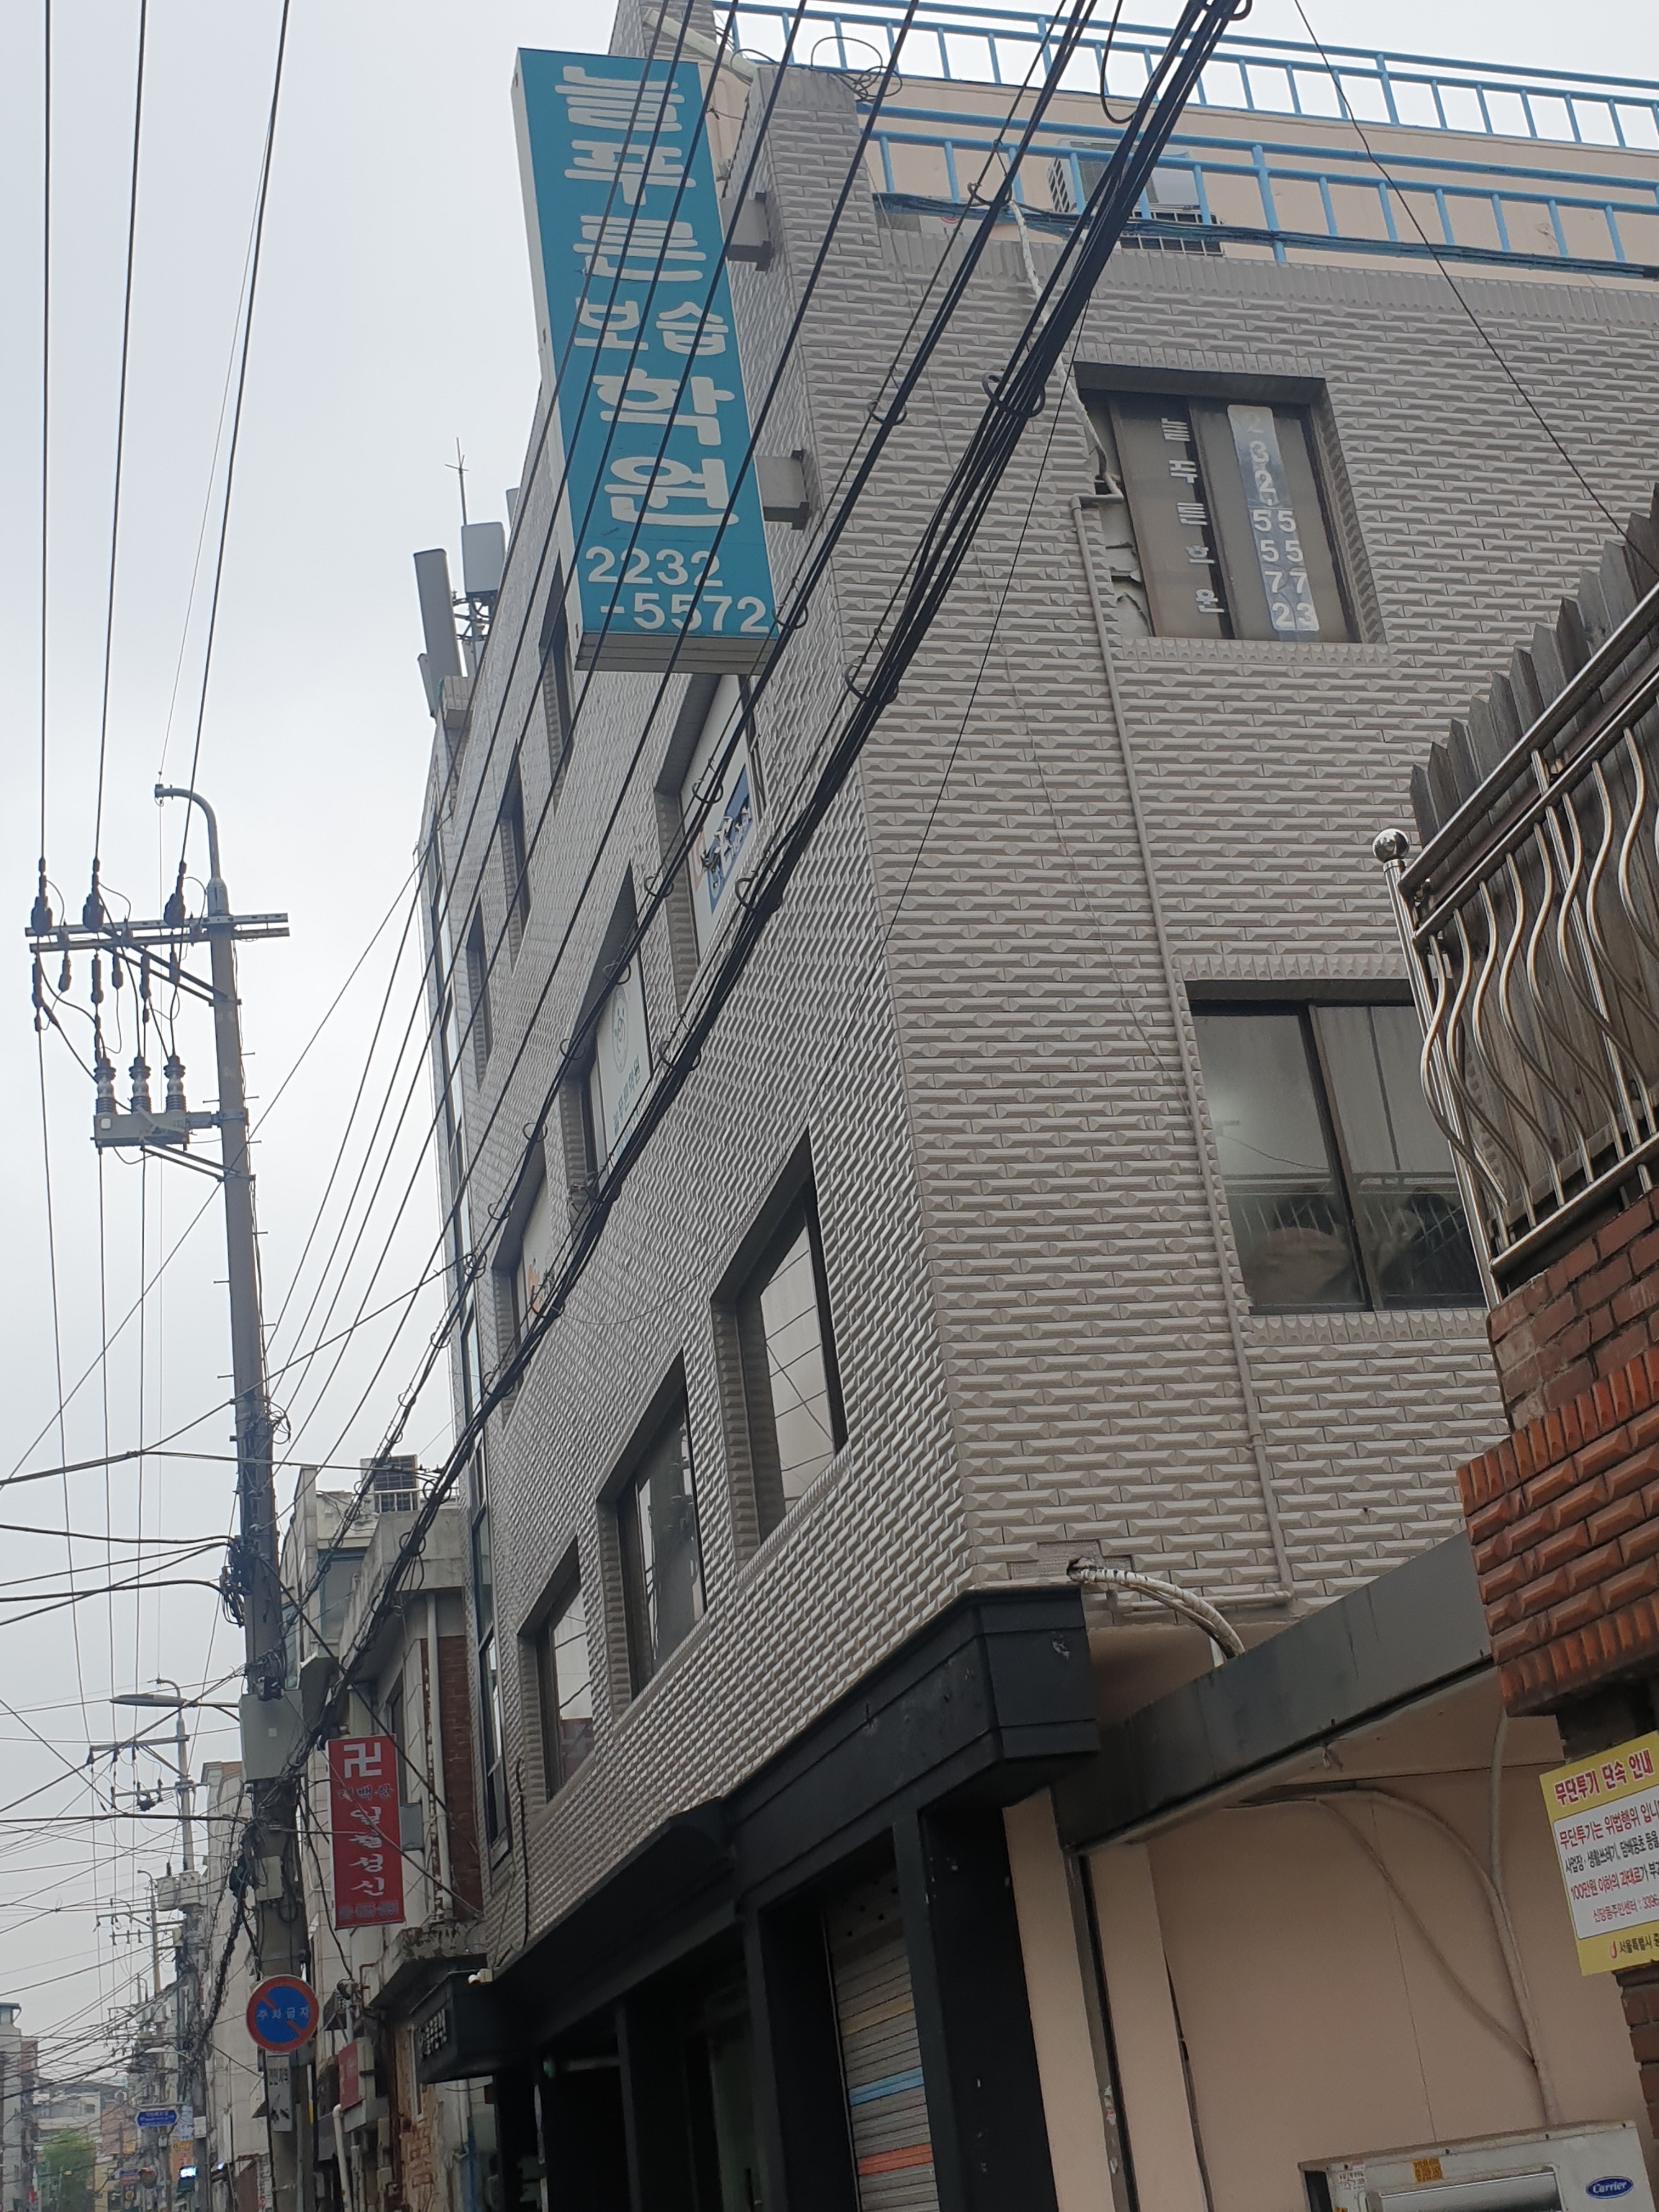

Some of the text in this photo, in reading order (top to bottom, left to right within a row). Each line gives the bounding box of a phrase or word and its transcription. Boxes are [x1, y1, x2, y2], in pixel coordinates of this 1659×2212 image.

[585, 546, 724, 588] 2232
[1554, 1749, 1654, 1806] 무단투기 단속 안내
[1559, 1799, 1659, 1850] 무단투기는 위법행위 입니
[1593, 2181, 1627, 2194] Carrier
